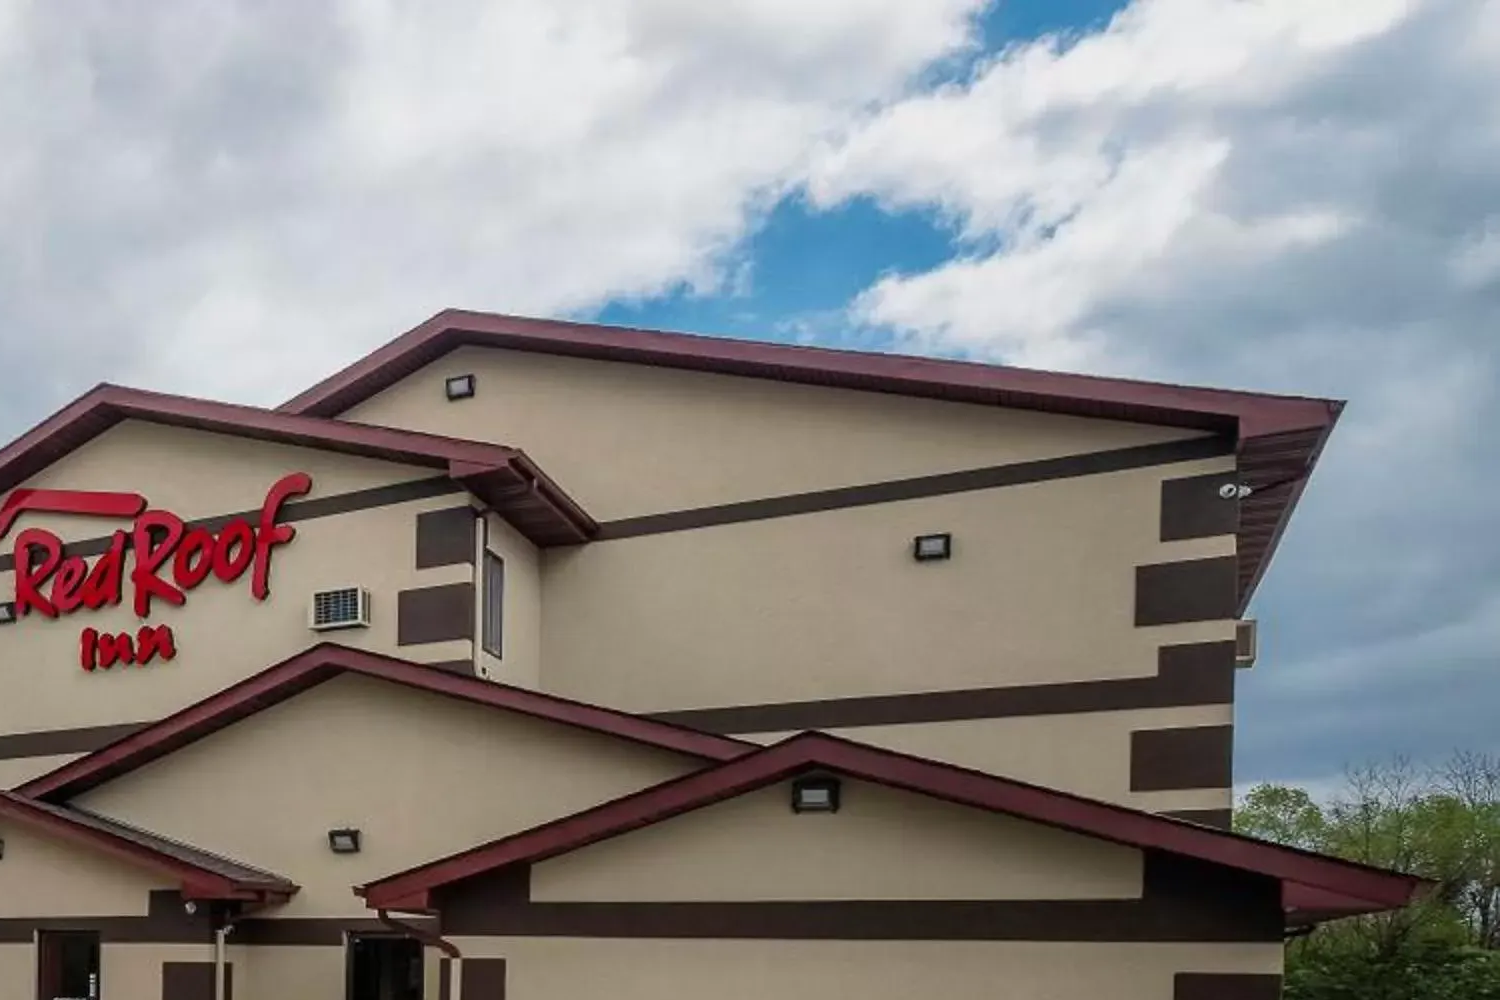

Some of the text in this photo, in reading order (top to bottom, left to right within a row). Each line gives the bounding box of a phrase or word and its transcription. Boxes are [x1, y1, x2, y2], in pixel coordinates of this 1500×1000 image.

[14, 471, 313, 619] Red Roof
[78, 623, 177, 673] Inn
